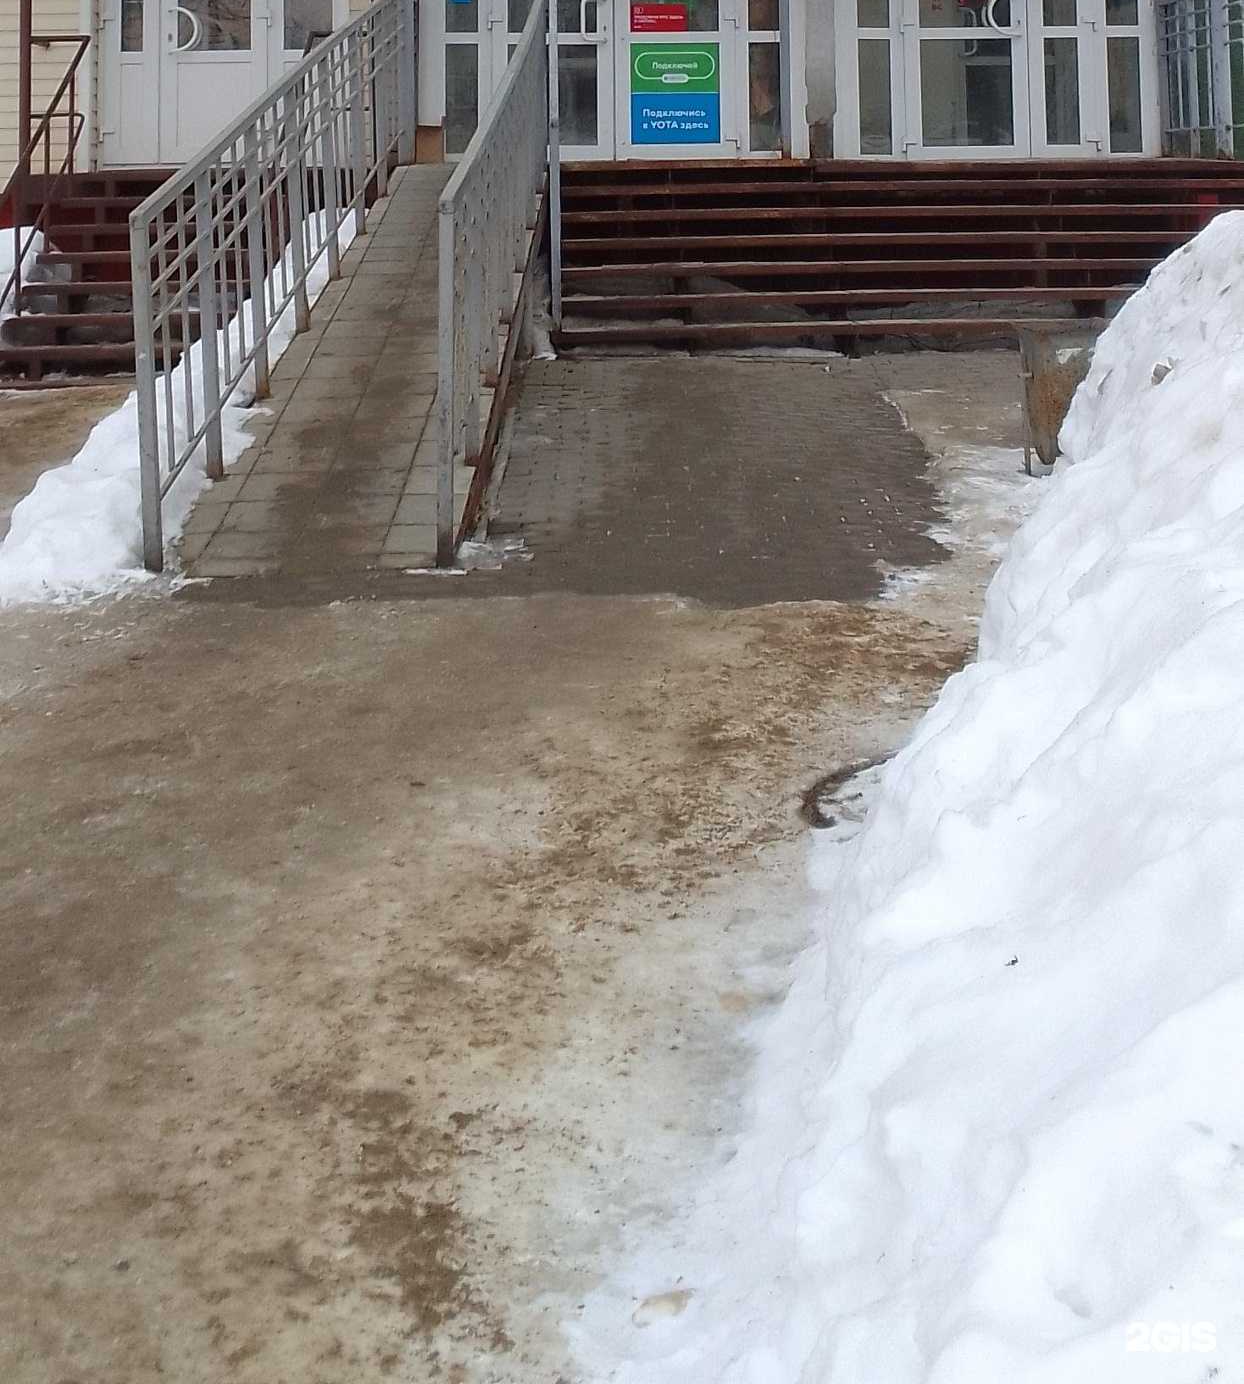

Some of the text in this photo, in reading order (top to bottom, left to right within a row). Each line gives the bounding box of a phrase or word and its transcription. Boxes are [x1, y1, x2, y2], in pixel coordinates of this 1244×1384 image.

[642, 108, 706, 118] Подключись
[650, 120, 679, 129] YOTA
[680, 122, 709, 130] здесь
